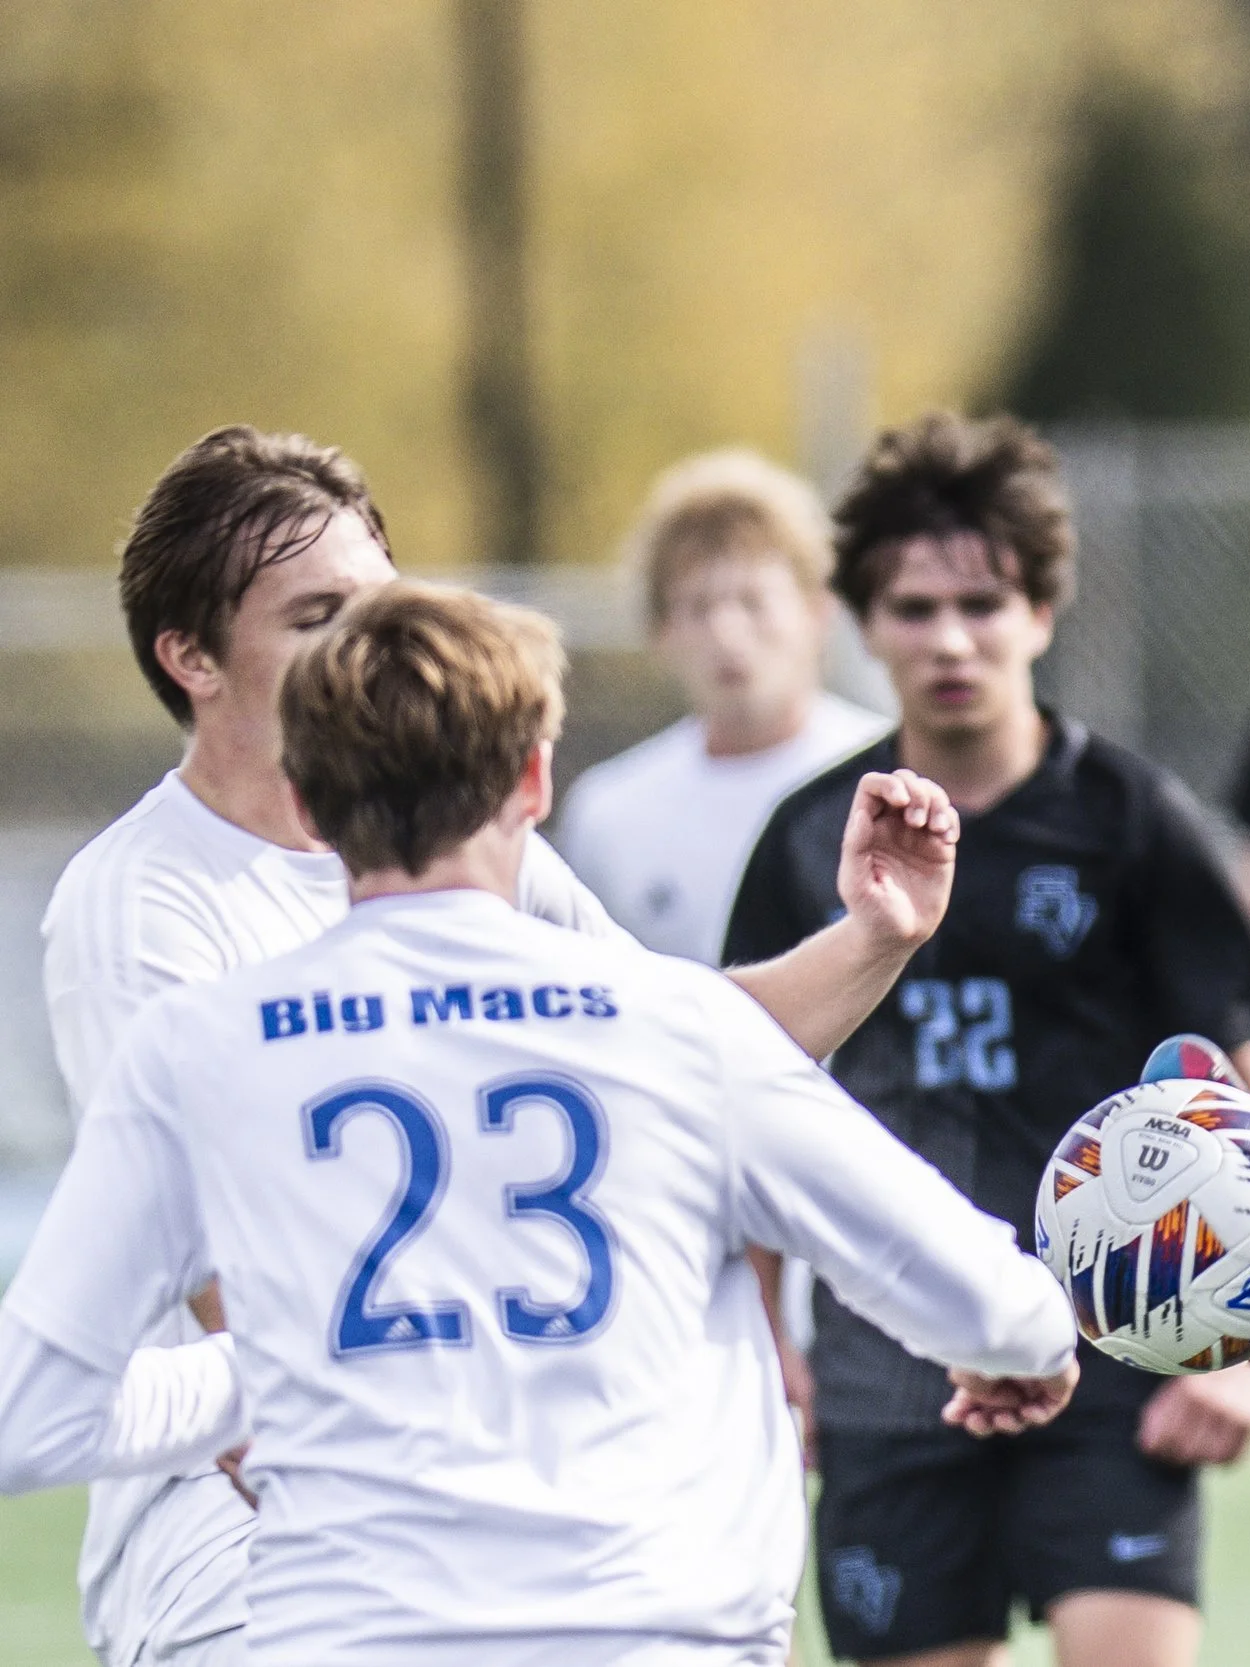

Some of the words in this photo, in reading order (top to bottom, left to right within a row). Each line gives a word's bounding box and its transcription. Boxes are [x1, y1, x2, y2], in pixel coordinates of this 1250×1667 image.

[259, 991, 385, 1041] Big
[409, 981, 619, 1026] Macs
[901, 977, 1019, 1090] 22
[1144, 1117, 1191, 1138] NCAA
[301, 1069, 623, 1362] 23
